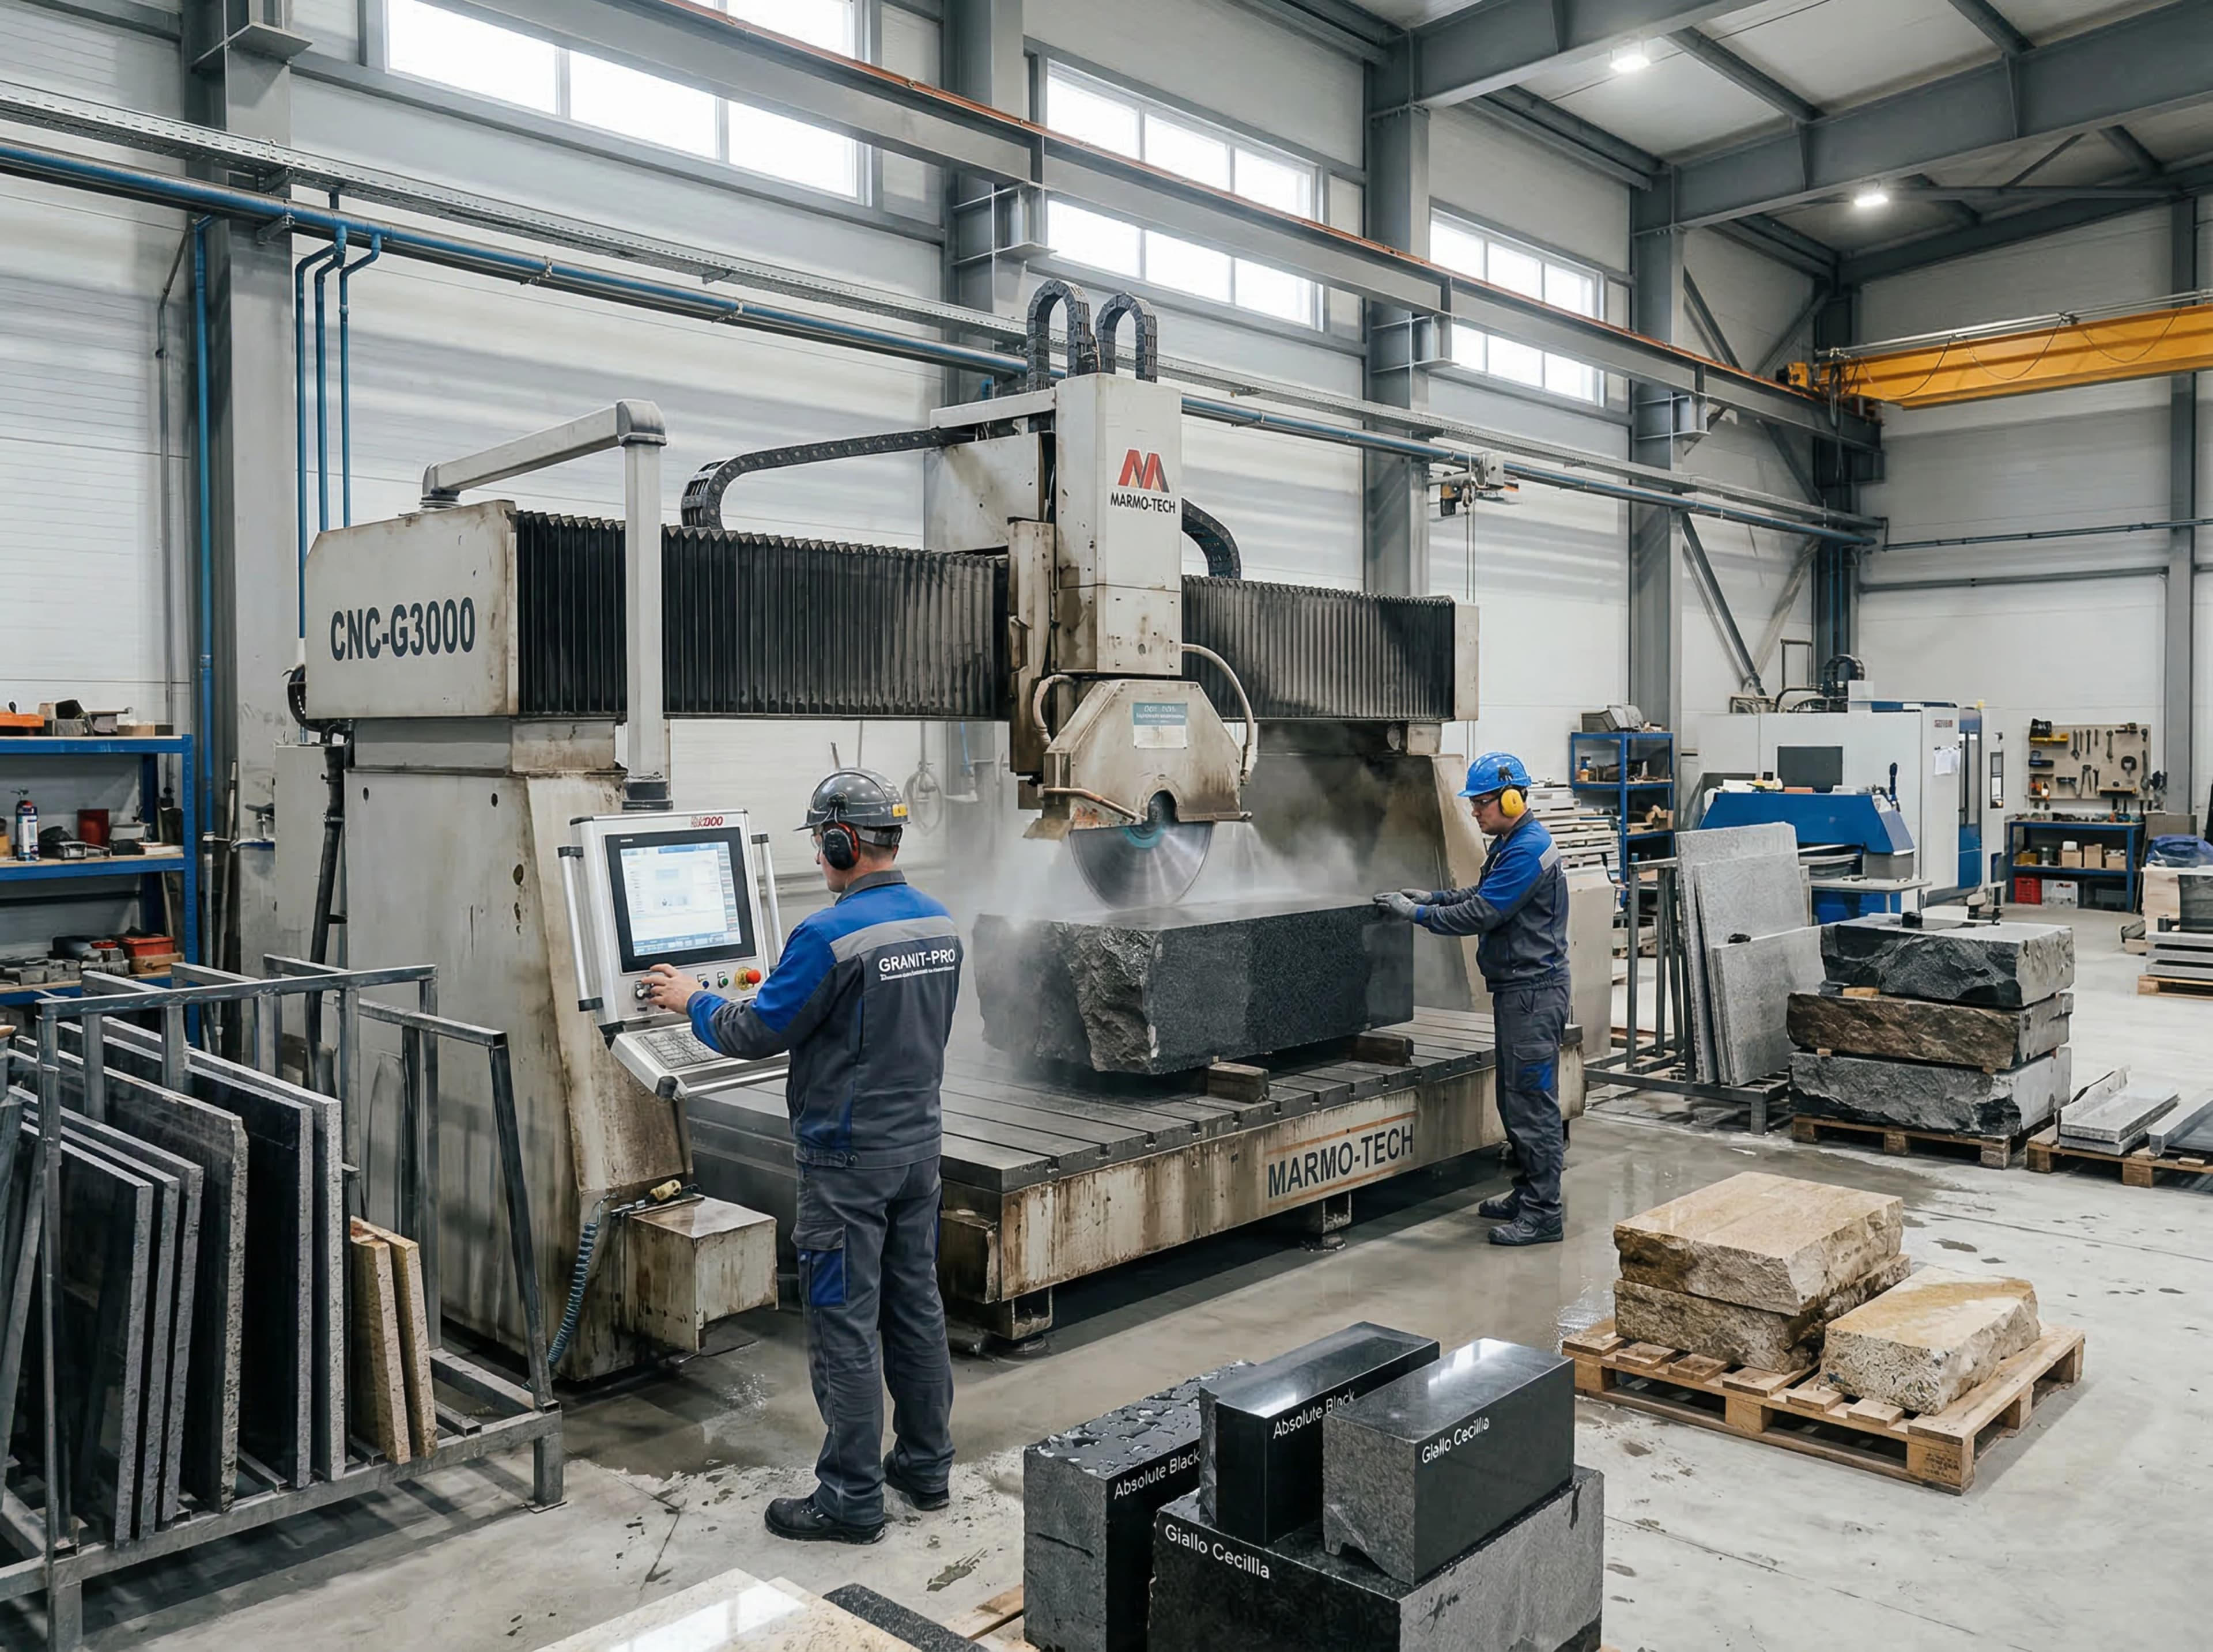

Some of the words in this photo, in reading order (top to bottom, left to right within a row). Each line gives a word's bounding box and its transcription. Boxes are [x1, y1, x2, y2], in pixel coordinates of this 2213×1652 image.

[1111, 492, 1176, 514] MARMO-TECH
[330, 597, 475, 661] CNC-G3000
[879, 949, 956, 973] GRANIT-PRO
[1268, 1124, 1414, 1199] MARMO-TECH
[1272, 1406, 1323, 1439] Absolute
[1114, 1466, 1166, 1500] Absolute
[1169, 1448, 1200, 1474] Black
[1165, 1524, 1208, 1554] Giallo
